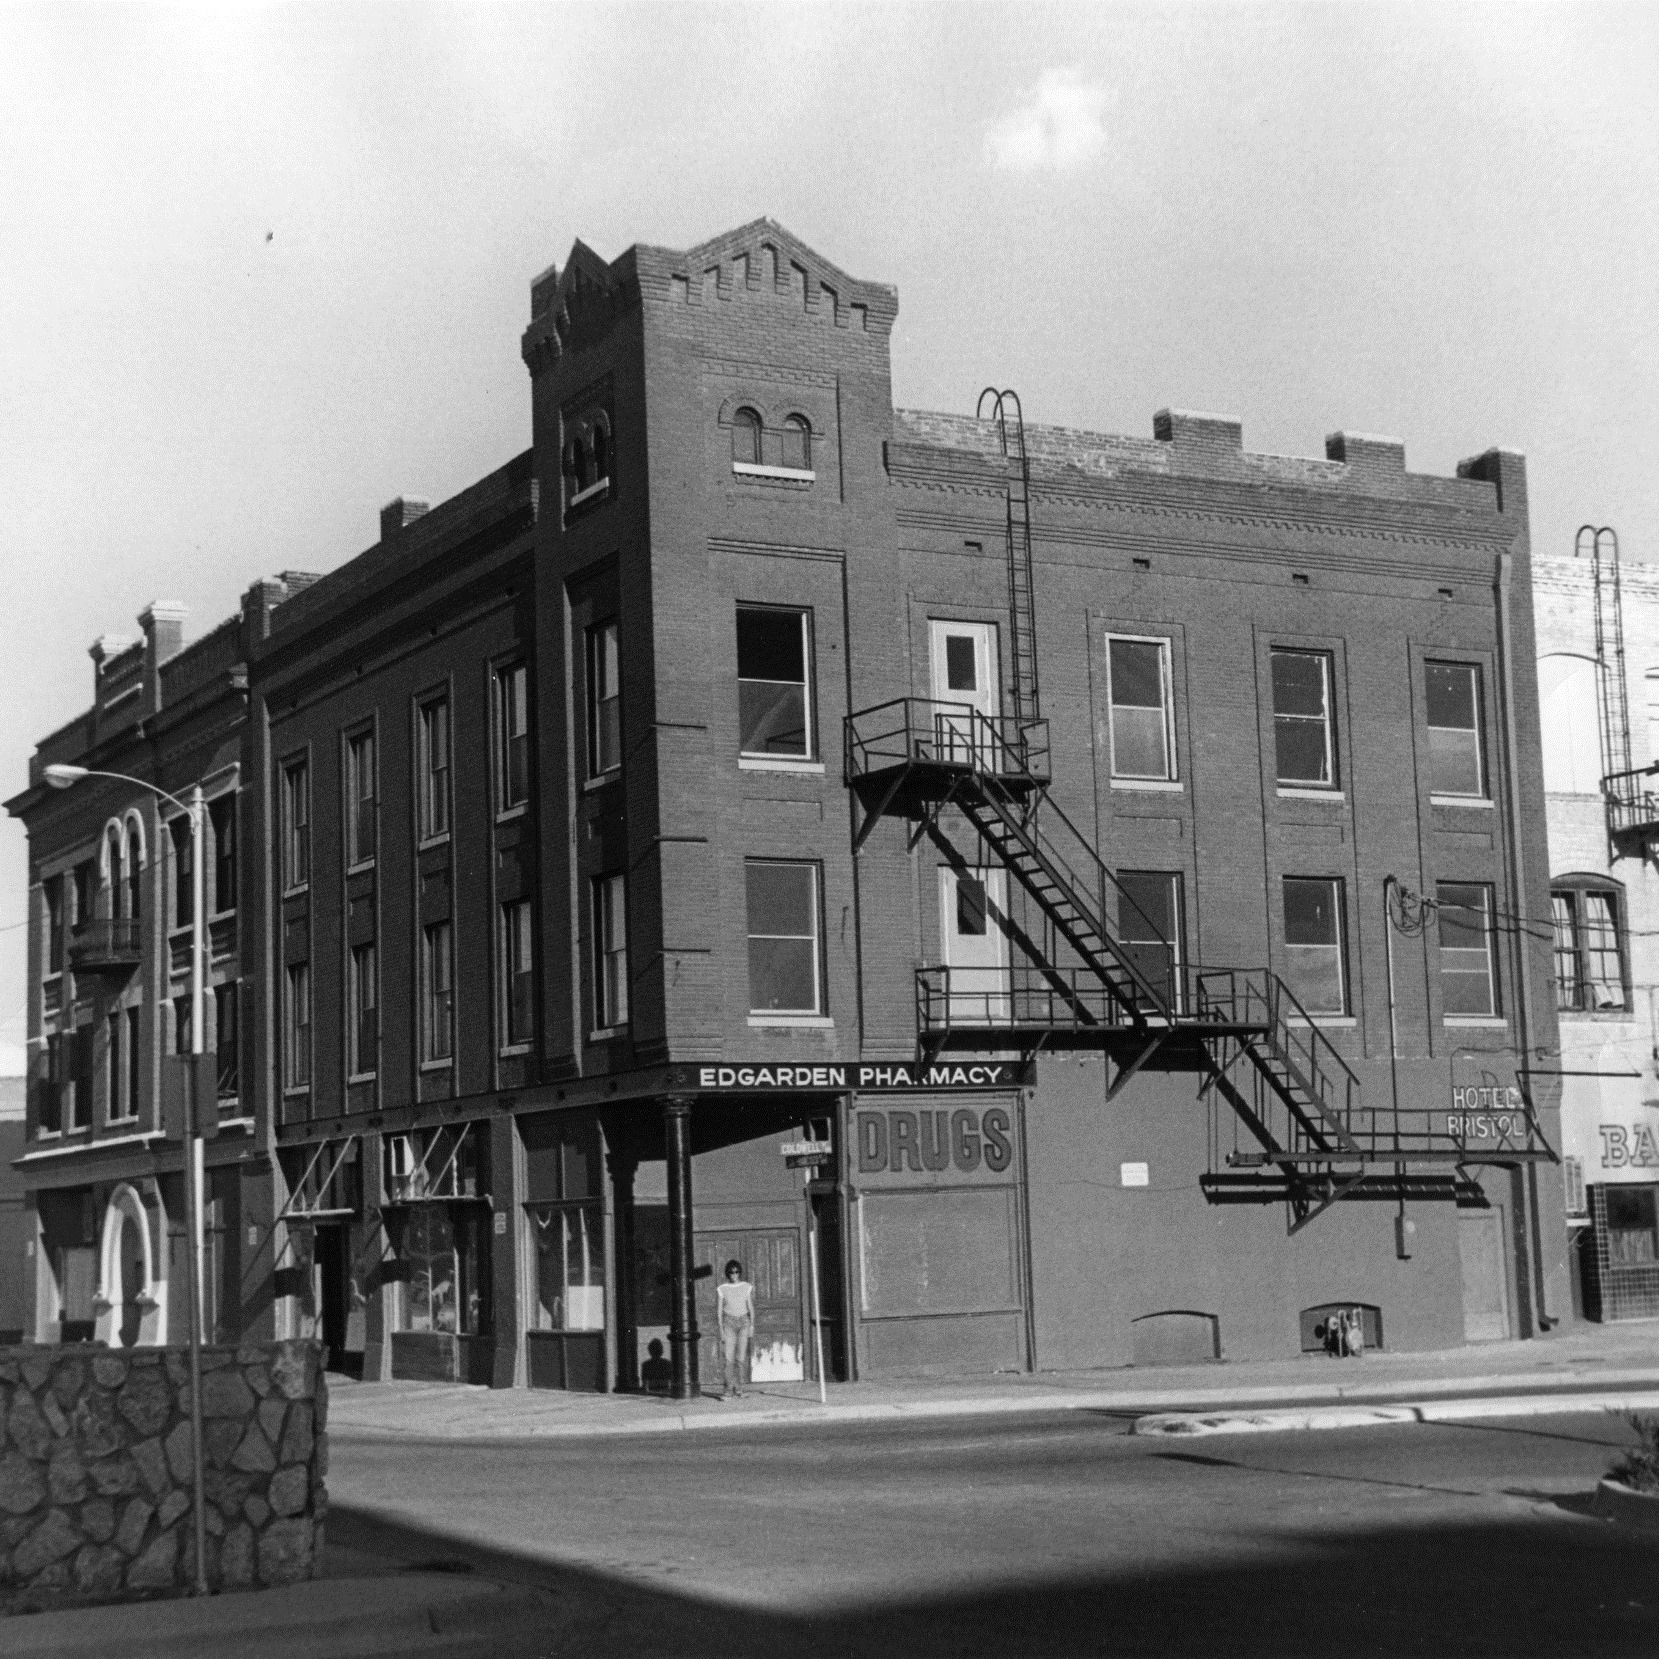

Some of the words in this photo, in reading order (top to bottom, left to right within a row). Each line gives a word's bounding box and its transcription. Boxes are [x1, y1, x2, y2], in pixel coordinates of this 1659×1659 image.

[700, 1067, 846, 1087] EDGARDEN
[859, 1066, 1003, 1086] PHAMACY
[1453, 1086, 1518, 1109] HOTEL
[1447, 1115, 1523, 1138] BRISTOL
[857, 1108, 1012, 1173] DRUGS
